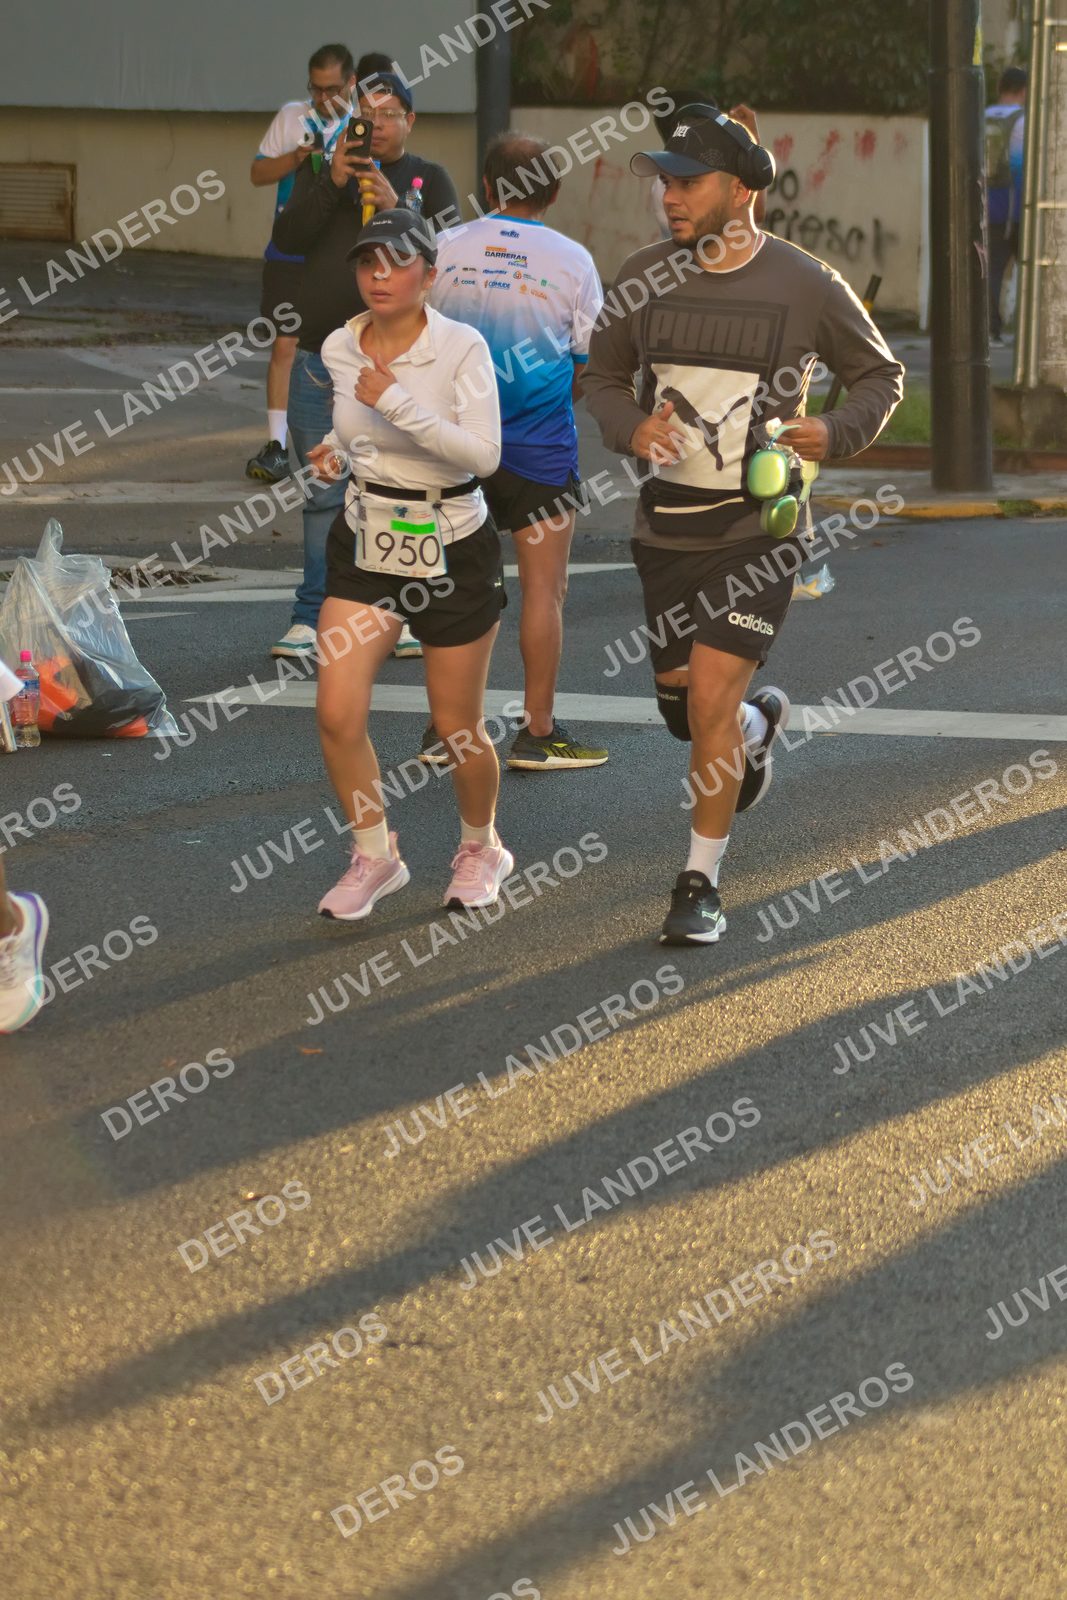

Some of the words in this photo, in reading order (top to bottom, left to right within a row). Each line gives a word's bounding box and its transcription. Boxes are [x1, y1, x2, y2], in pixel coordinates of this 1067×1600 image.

[485, 251, 527, 261] CARRERAS
[648, 308, 771, 359] PUMA
[360, 528, 440, 567] 1950
[728, 612, 774, 636] adidas
